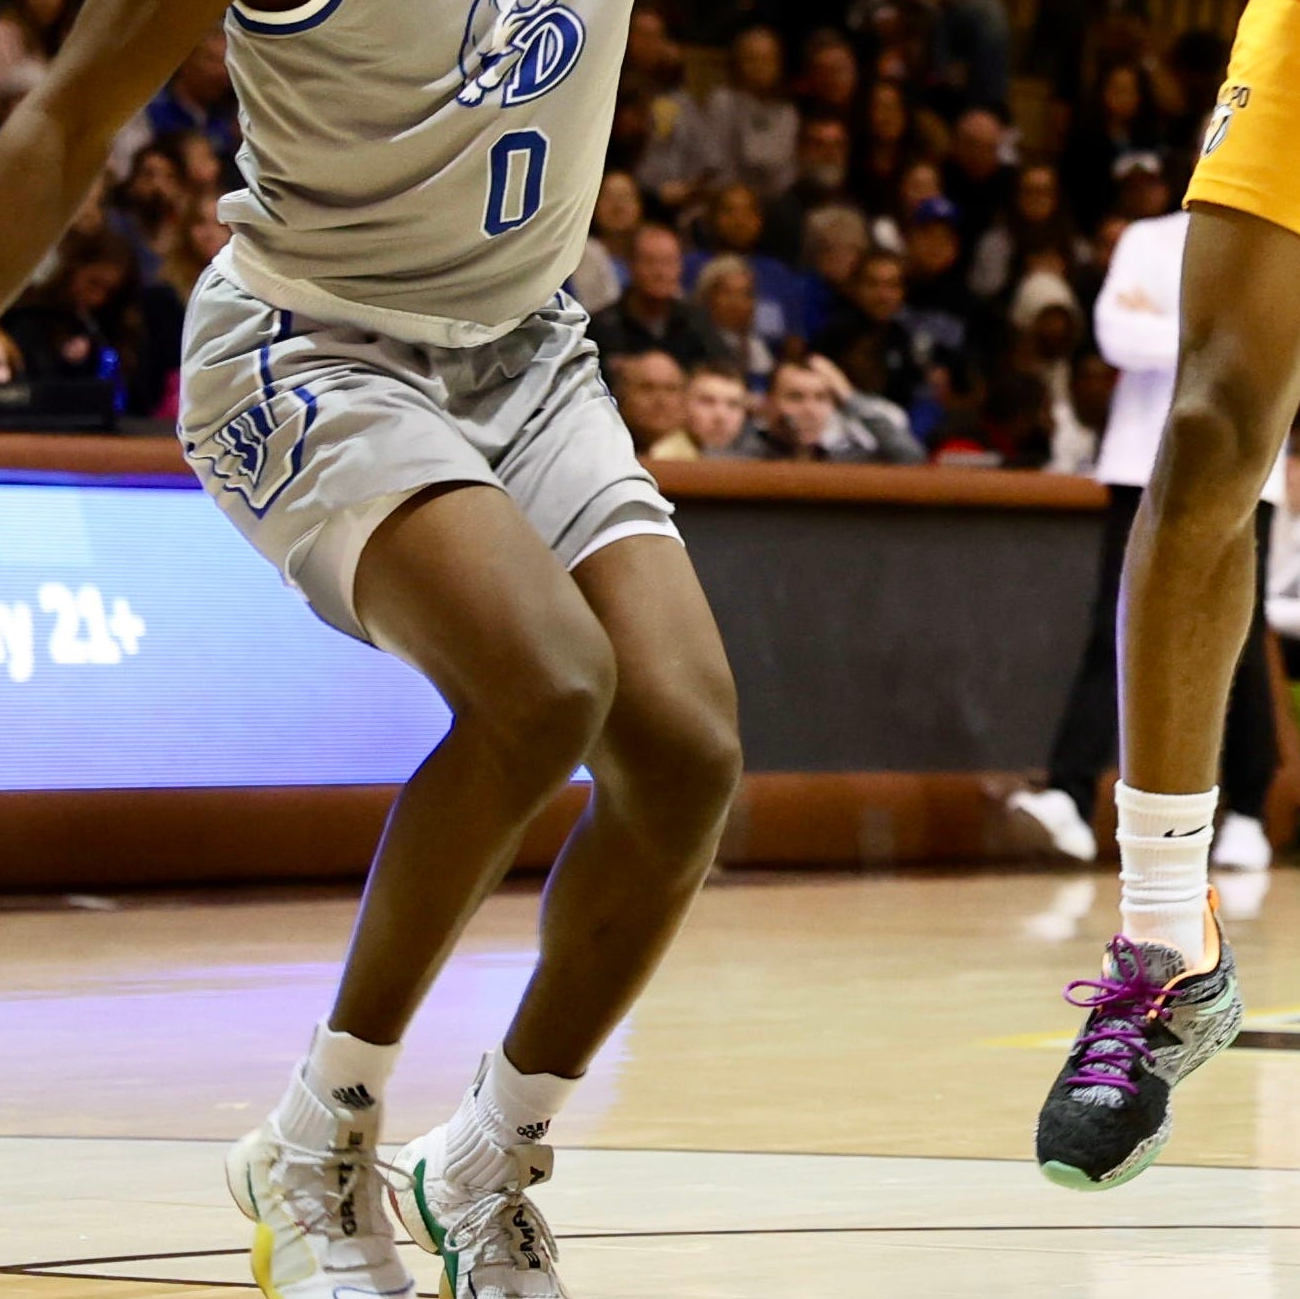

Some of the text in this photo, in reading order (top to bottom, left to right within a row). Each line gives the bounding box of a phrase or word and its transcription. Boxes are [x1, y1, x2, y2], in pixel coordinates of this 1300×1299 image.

[500, 2, 586, 109] D
[479, 126, 550, 240] 0
[37, 581, 147, 665] 21+
